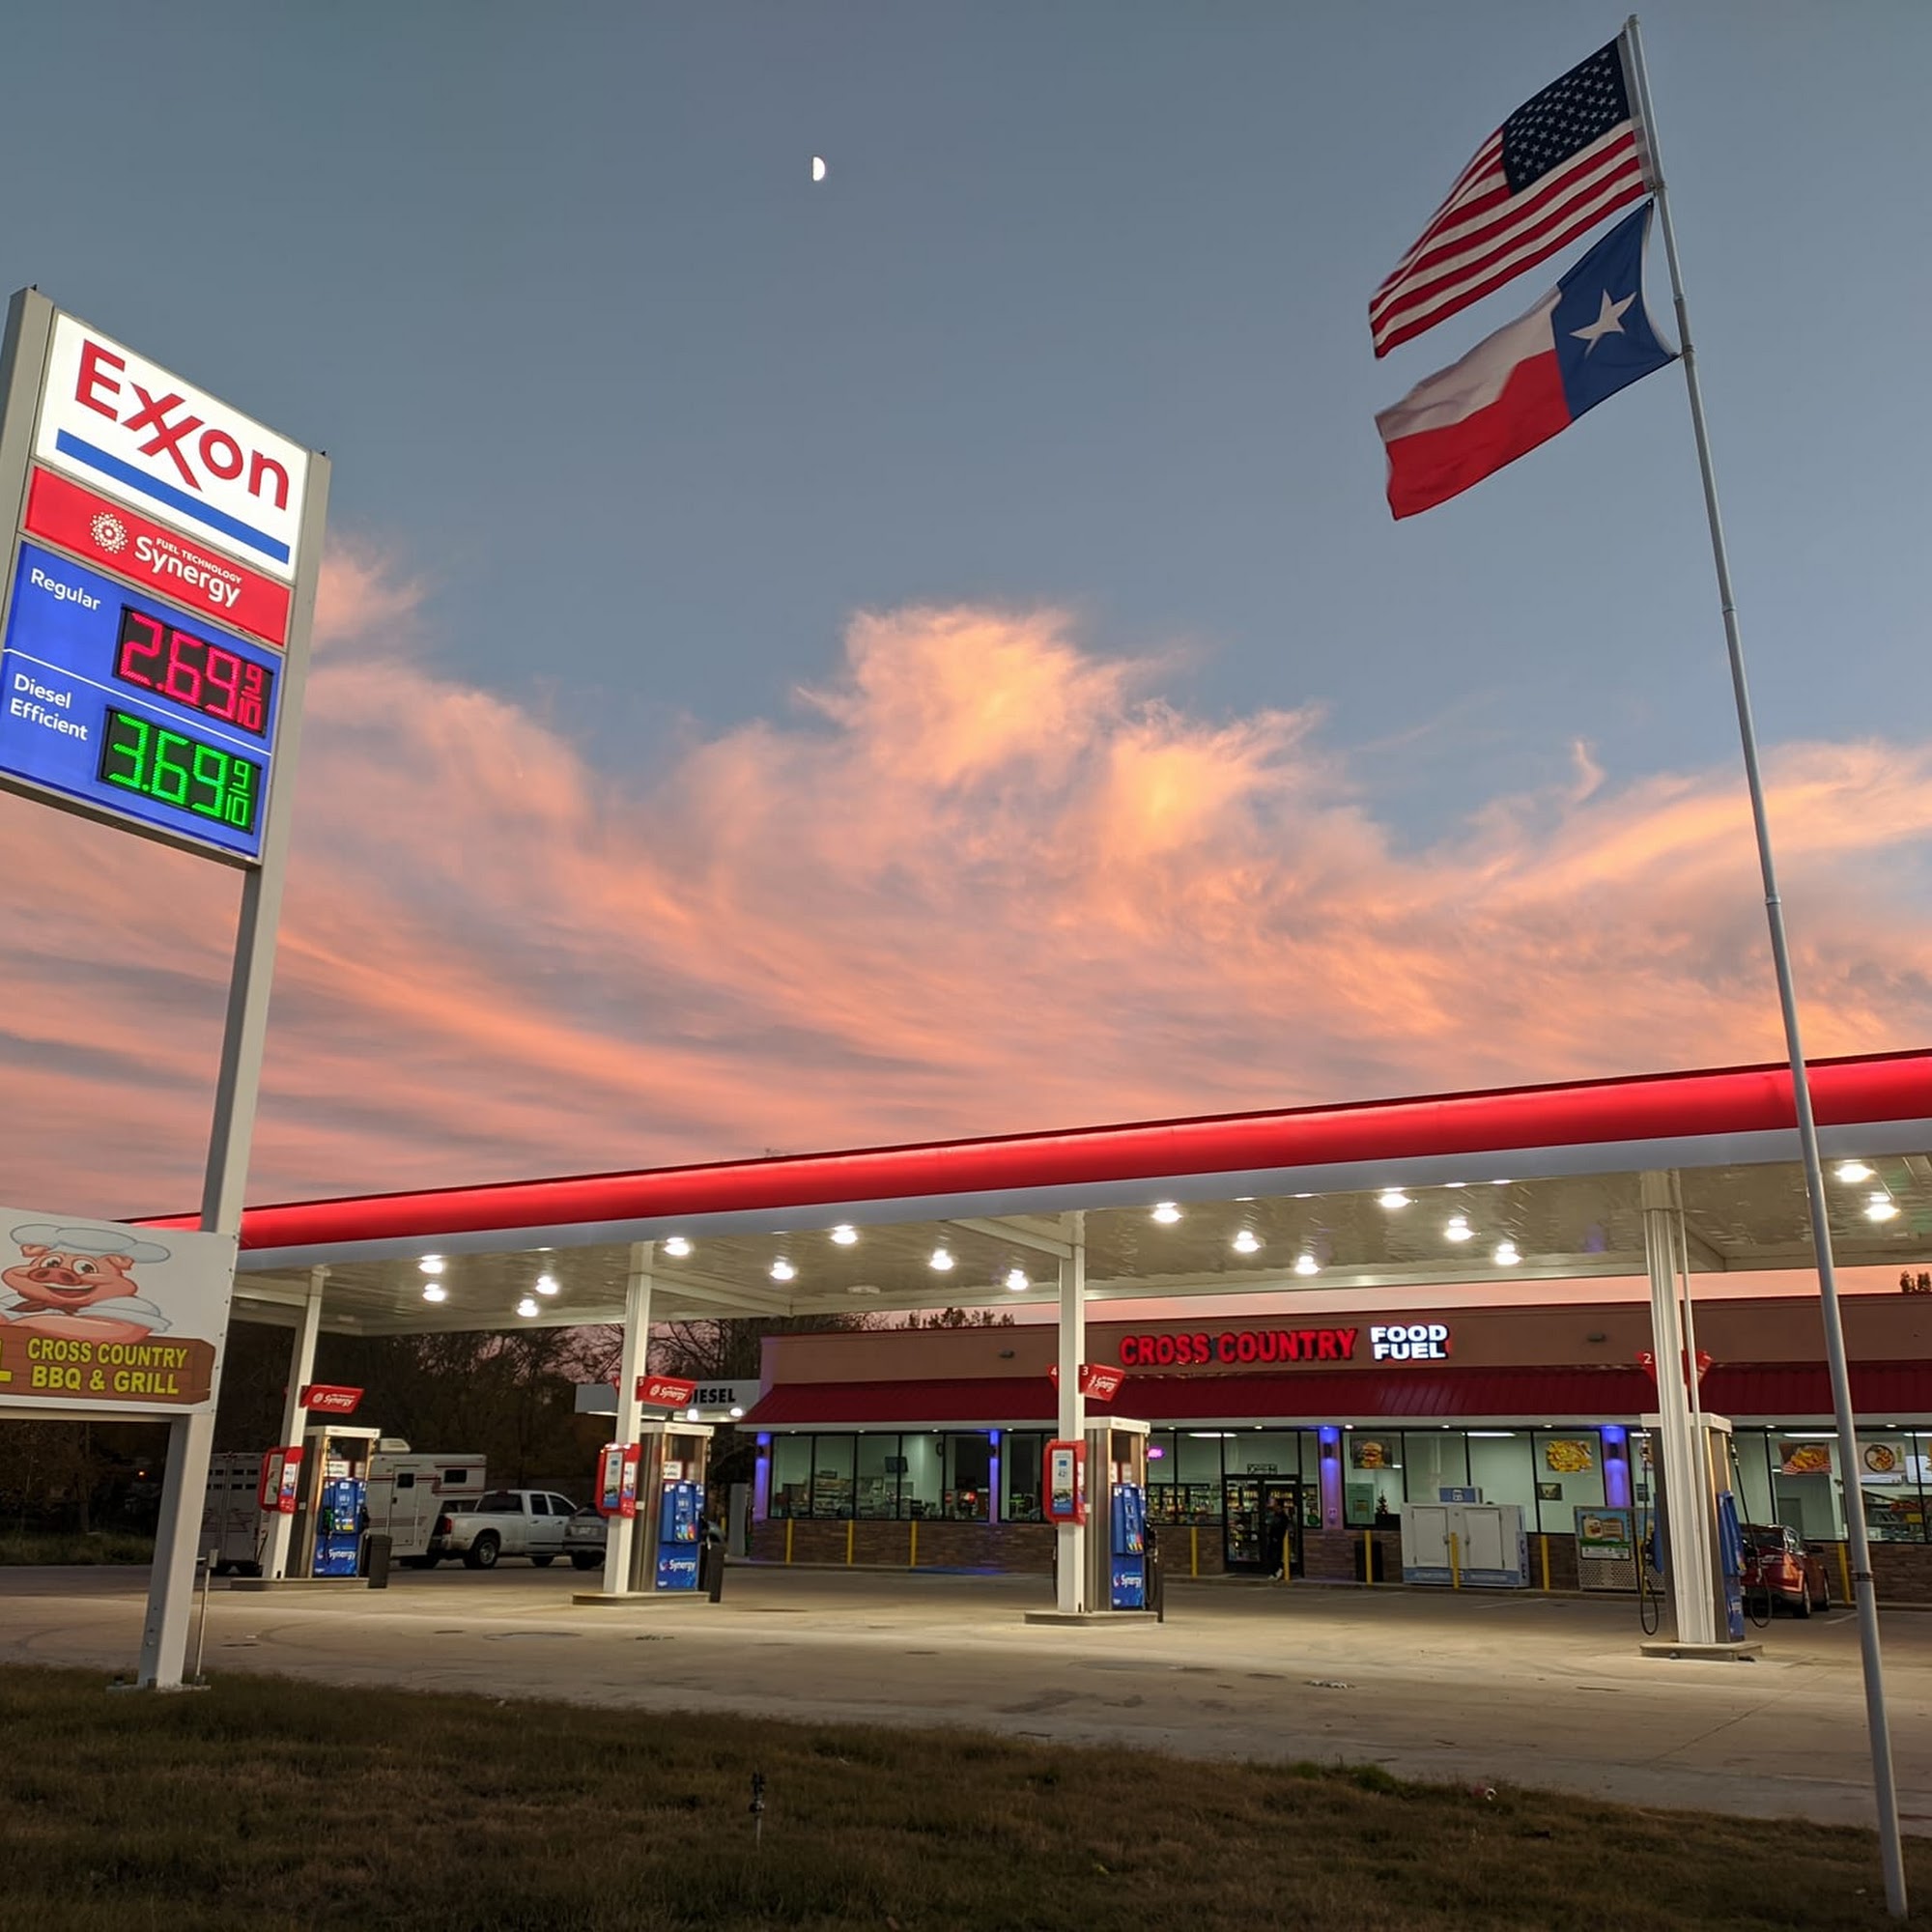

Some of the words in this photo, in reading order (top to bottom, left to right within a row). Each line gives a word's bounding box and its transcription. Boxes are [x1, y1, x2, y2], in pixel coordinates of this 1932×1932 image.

[74, 338, 290, 511] Exxon
[134, 536, 242, 608] Synergy
[156, 537, 180, 555] FUEL
[182, 548, 242, 584] TECHNOLOGY
[31, 568, 100, 611] Regular
[120, 612, 242, 719] 2.69
[14, 672, 71, 709] Diesel
[10, 697, 88, 741] Efficient
[109, 714, 229, 817] 3.69
[1120, 1332, 1210, 1366] CROSS
[1217, 1328, 1357, 1363] COUNTRY
[1370, 1324, 1448, 1343] FOOD
[1374, 1342, 1447, 1361] FUEL
[28, 1338, 92, 1363] CROSS
[98, 1343, 187, 1368] COUNTRY
[1082, 1366, 1089, 1377] 3
[1643, 1352, 1653, 1364] 2
[31, 1365, 81, 1391] BBQ
[89, 1369, 105, 1391] &
[113, 1371, 180, 1395] GRILL
